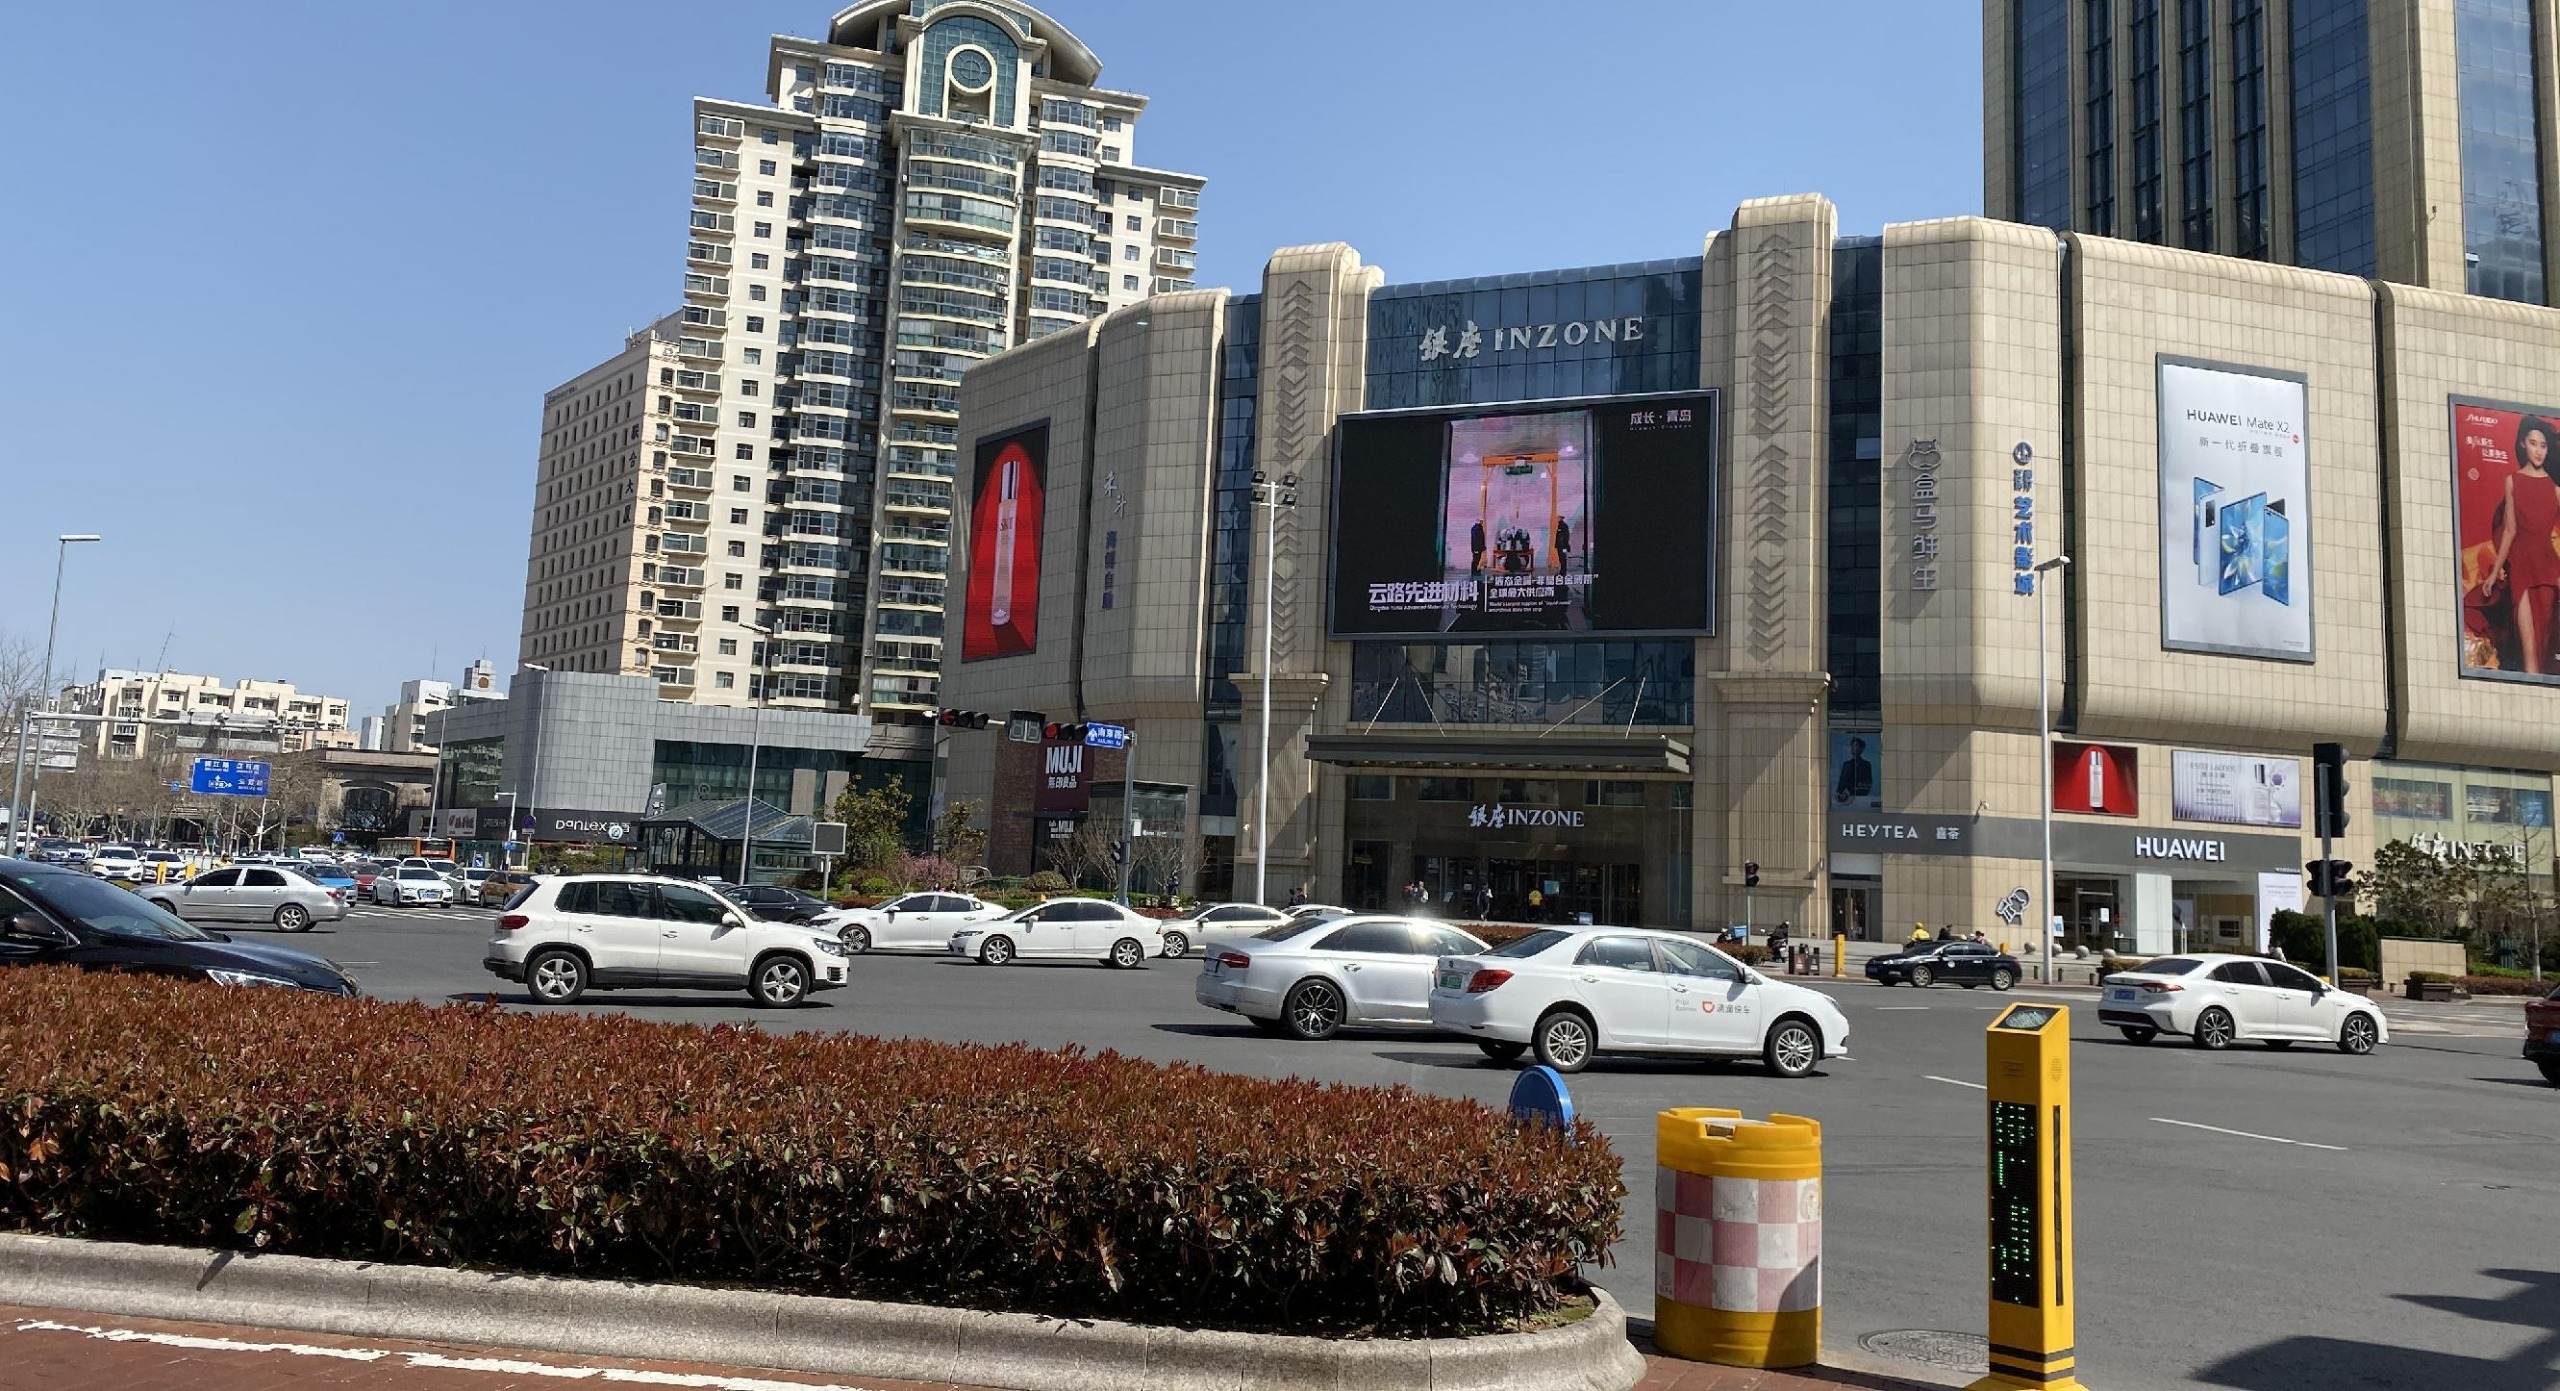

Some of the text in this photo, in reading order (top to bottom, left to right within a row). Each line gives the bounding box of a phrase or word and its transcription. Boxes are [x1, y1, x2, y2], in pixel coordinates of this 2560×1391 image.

[1494, 315, 1644, 351] INZONE
[2186, 408, 2291, 433] HUAWEI Mate X2
[1368, 580, 1480, 604] 云路先进材料
[1045, 745, 1083, 774] MUJI
[1508, 809, 1584, 827] INZONE
[1842, 823, 1960, 840] HEYTEA 喜茶
[2135, 836, 2226, 862] HUAWEI
